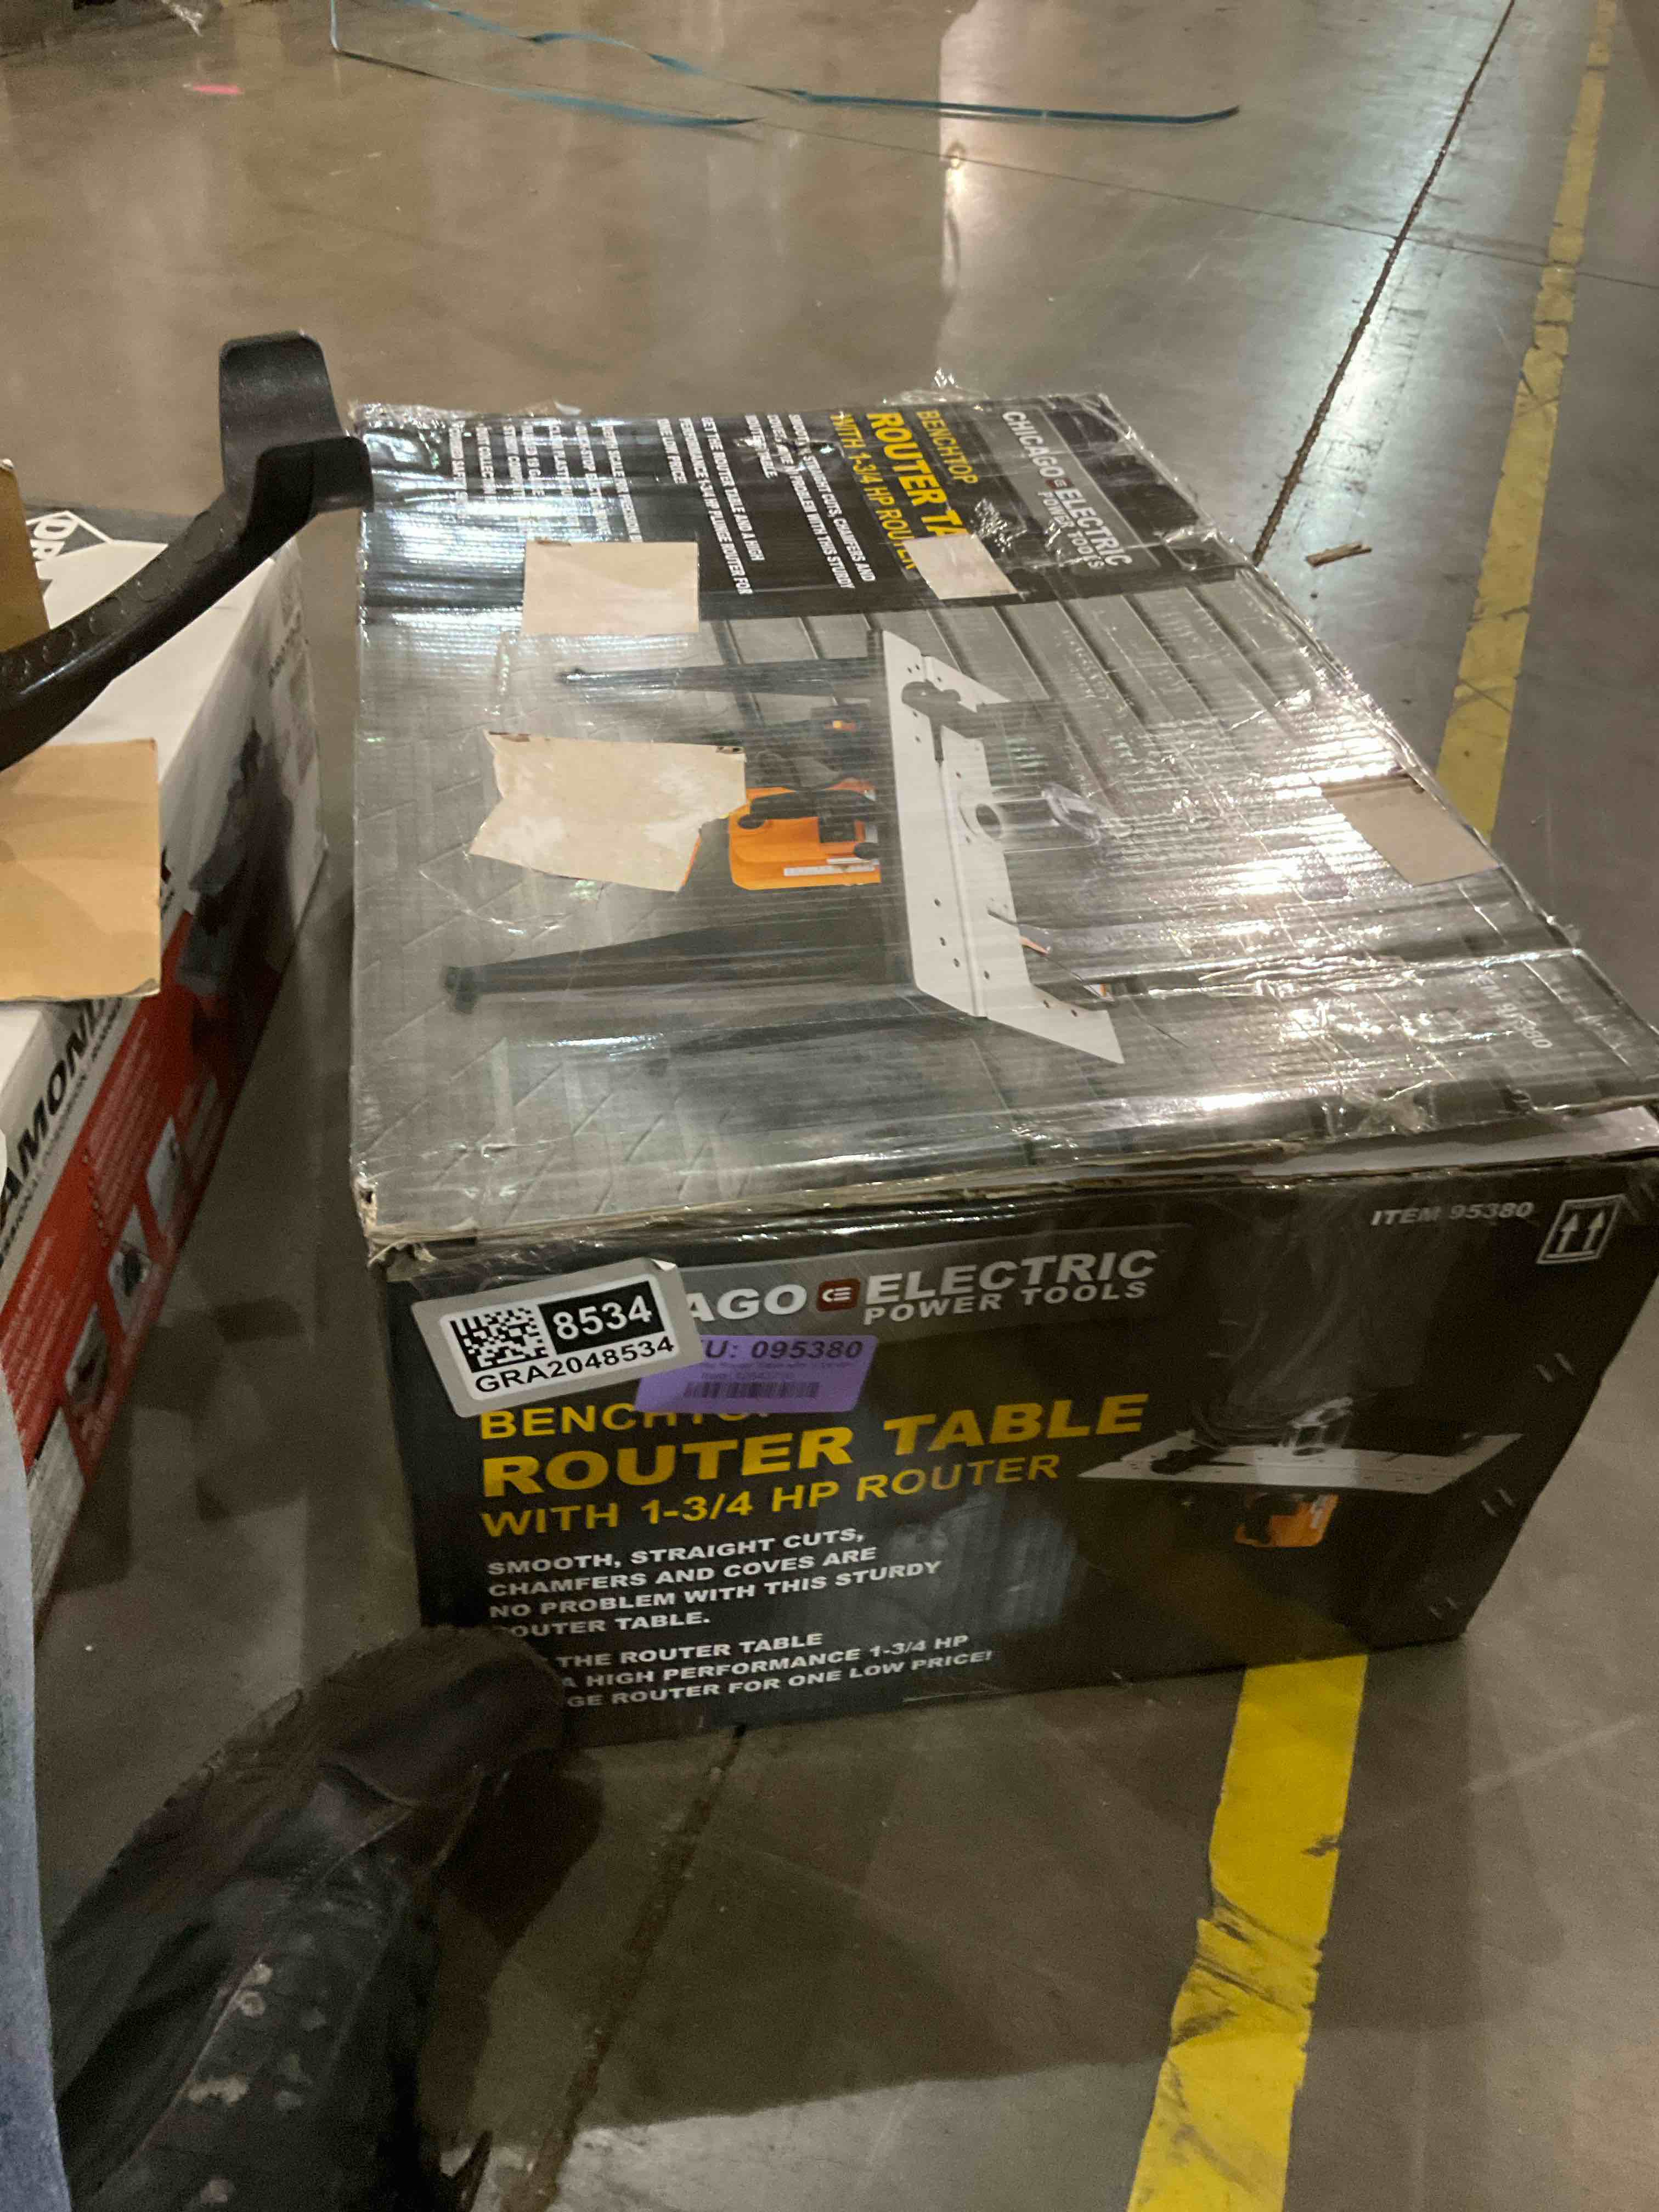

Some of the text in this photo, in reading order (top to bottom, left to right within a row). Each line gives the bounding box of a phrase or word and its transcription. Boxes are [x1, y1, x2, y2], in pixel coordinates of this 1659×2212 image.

[830, 412, 866, 448] WITH
[864, 487, 895, 505] HP
[866, 412, 947, 506] ROUTER
[916, 409, 978, 483] BENCHTOP
[1003, 411, 1132, 566] CHICAGO ELECTRIC
[1038, 492, 1104, 569] POWER TOOLS
[856, 562, 876, 582] AND
[1371, 1201, 1535, 1226] ITEM 95380
[864, 1281, 1149, 1325] POWER TOOLS
[865, 1250, 1158, 1305] ELECTRIC
[552, 1295, 652, 1340] 8534
[475, 1336, 675, 1392] GRA2048534
[751, 1340, 863, 1359] 095380
[482, 1393, 1149, 1497] ROUTER TABLE
[480, 1454, 1060, 1537] WITH 1-3/4 HP ROUTER
[488, 1527, 865, 1576] SMOOTH, STRAIGHT CUTS,
[489, 1547, 878, 1597] CHAMFERS AND COVES ARE
[490, 1560, 943, 1618] NO PROBLEM WITH THIS STURDY
[615, 1611, 711, 1630] TABLE.
[556, 1633, 823, 1668] THE ROUTER TABLE
[586, 1670, 654, 1688] HIGH
[663, 1648, 860, 1681] PERFORMANCE
[870, 1639, 927, 1657] 1-3/4
[934, 1635, 969, 1650] HP
[612, 1683, 720, 1705] ROUTER
[728, 1678, 781, 1693] FOR
[788, 1669, 843, 1687] ONE
[849, 1661, 905, 1679] LOW
[911, 1650, 994, 1671] PRICE!
